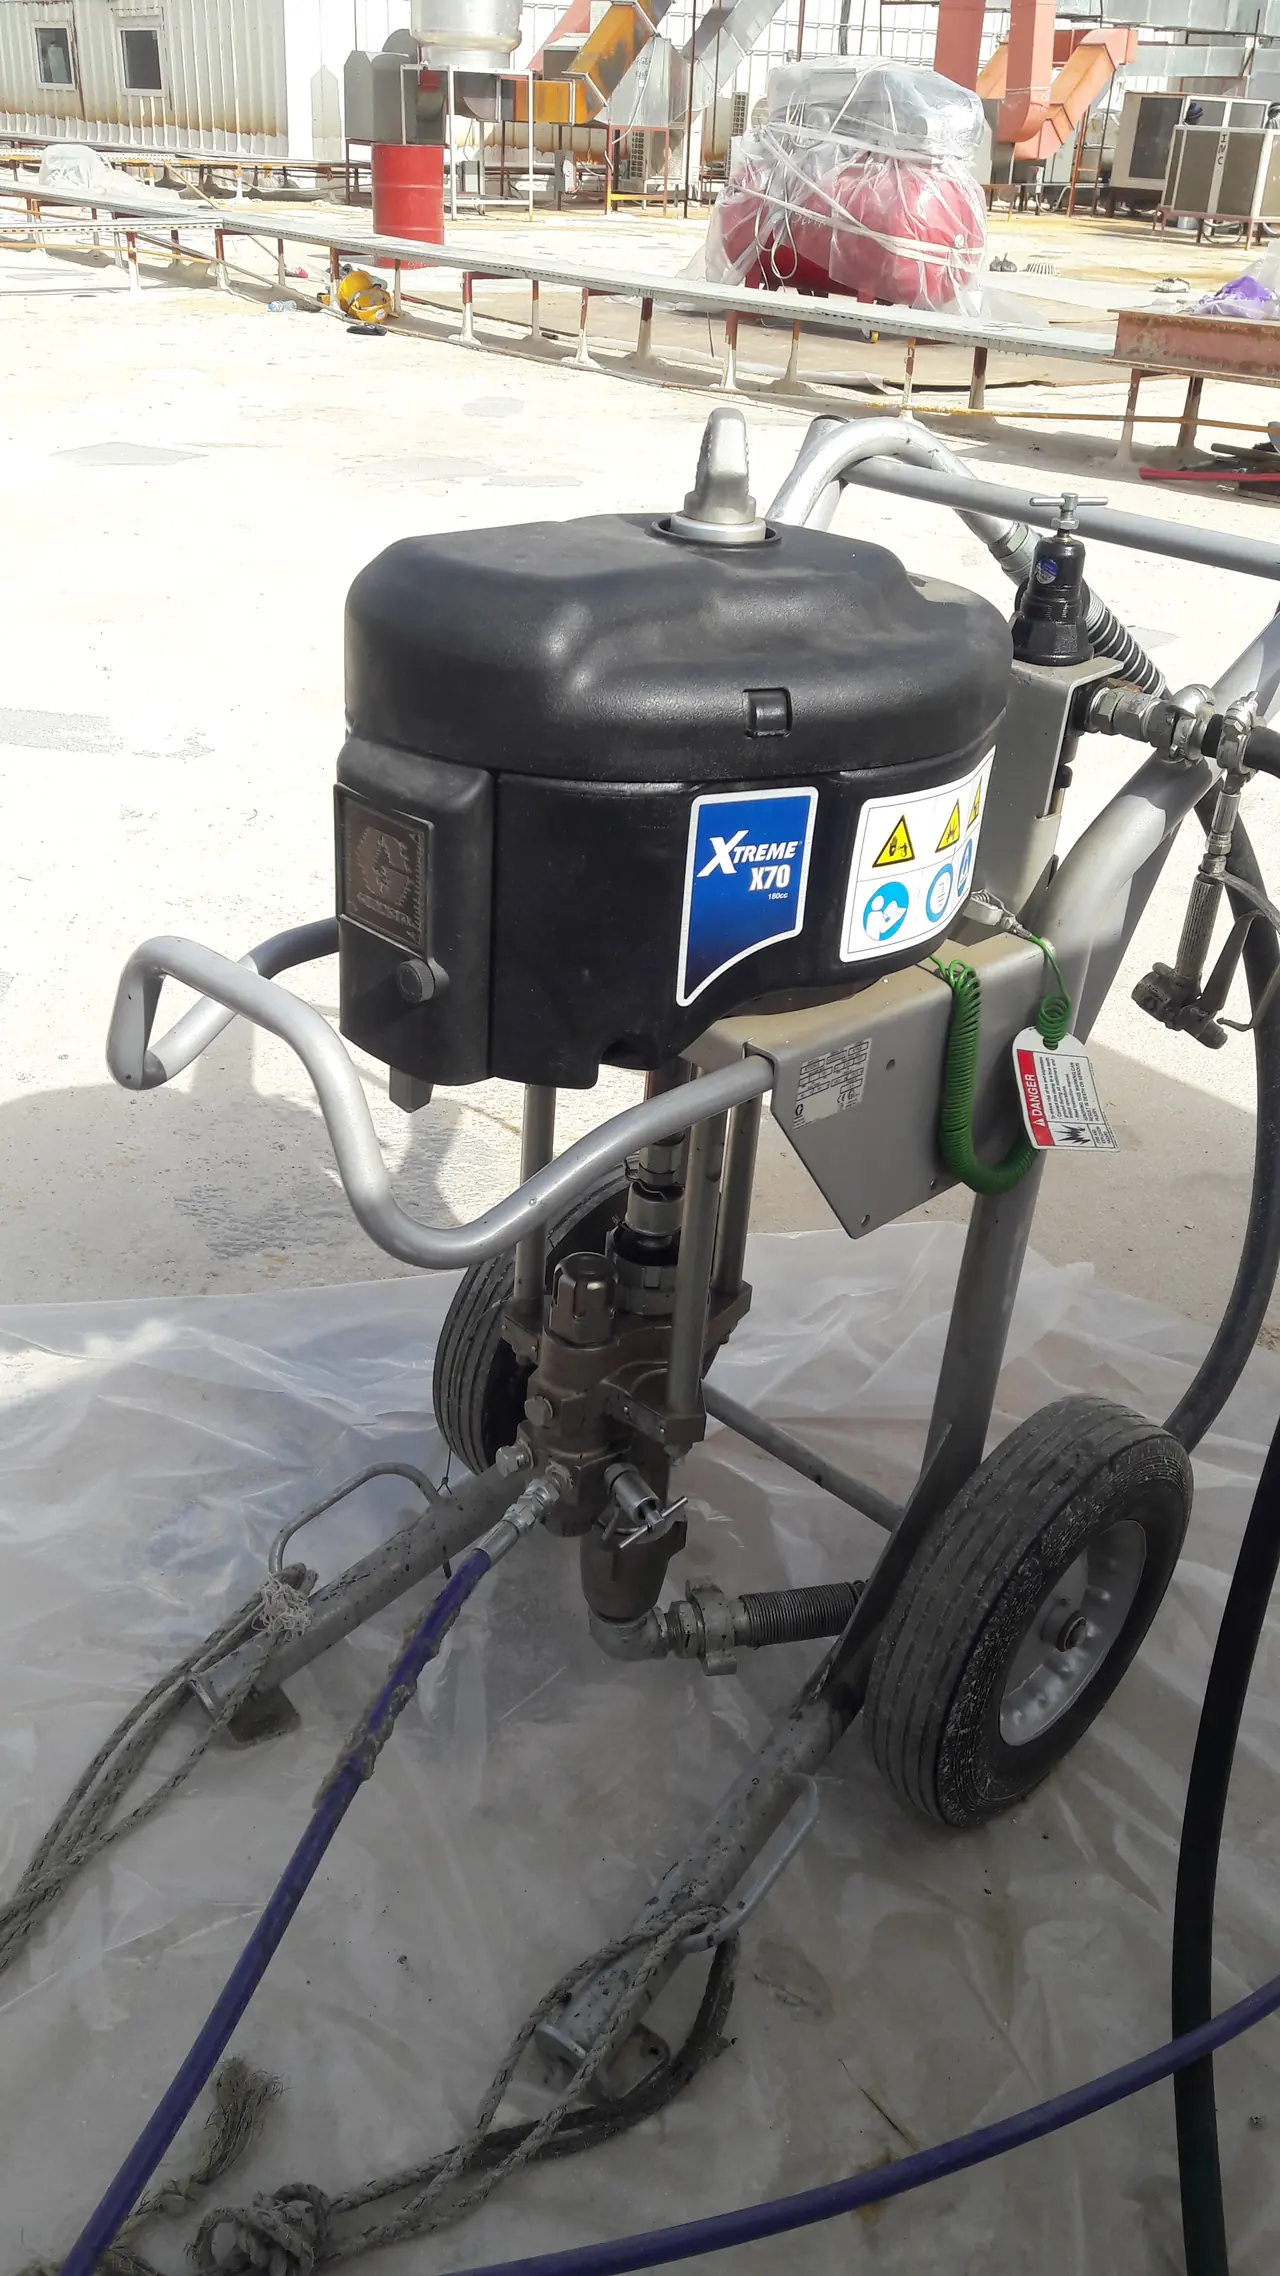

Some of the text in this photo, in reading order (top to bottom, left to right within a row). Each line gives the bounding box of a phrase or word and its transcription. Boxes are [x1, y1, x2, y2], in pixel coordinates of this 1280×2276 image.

[1217, 134, 1227, 165] INC
[696, 829, 799, 878] XTREME
[749, 864, 791, 892] X70
[768, 892, 788, 900] 180cc
[1024, 1073, 1045, 1117] DANGER
